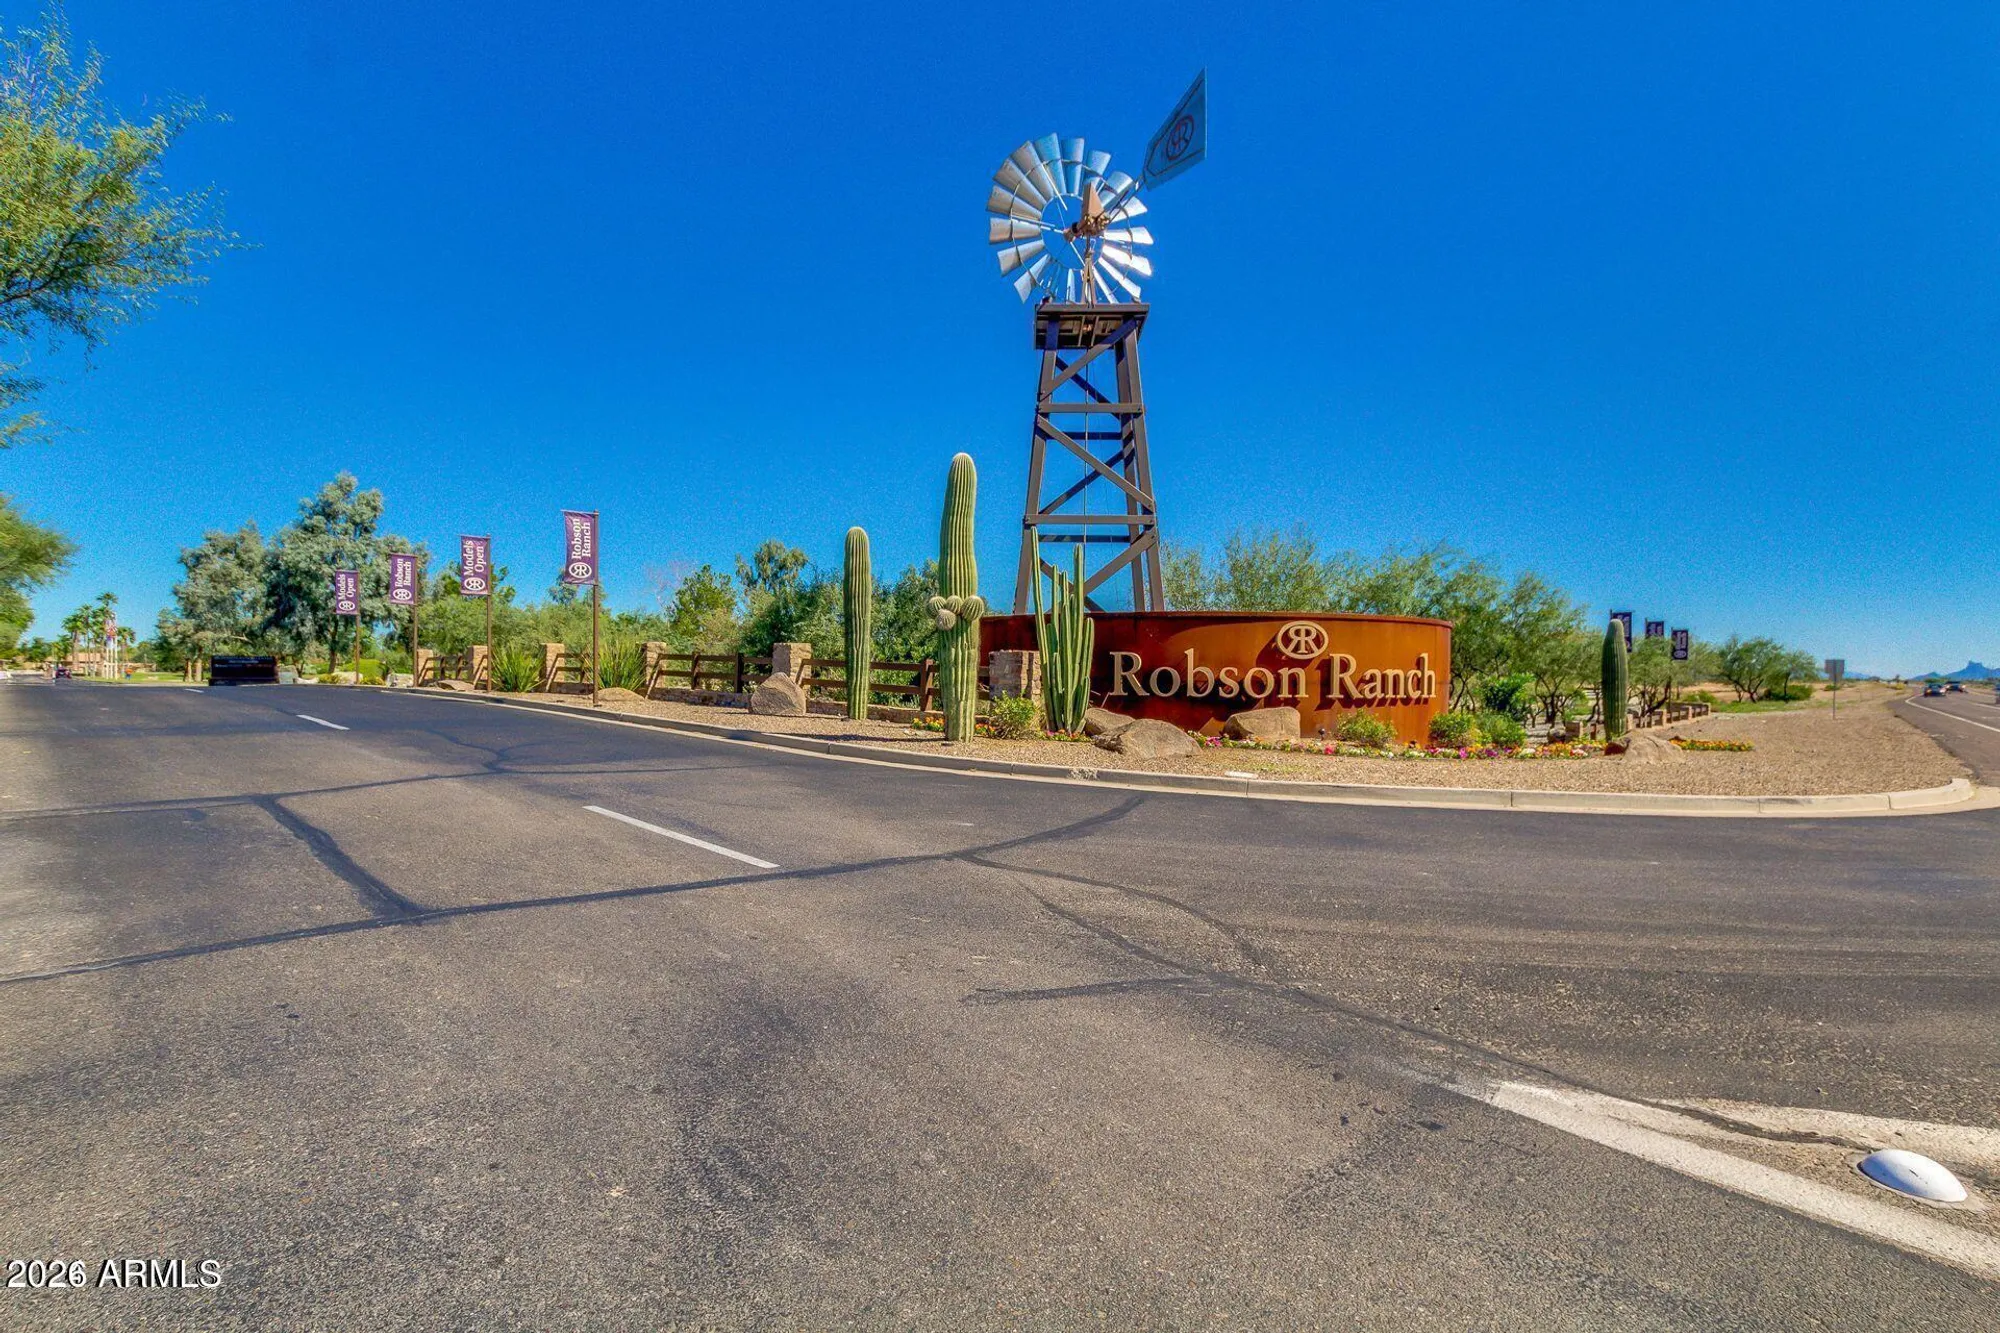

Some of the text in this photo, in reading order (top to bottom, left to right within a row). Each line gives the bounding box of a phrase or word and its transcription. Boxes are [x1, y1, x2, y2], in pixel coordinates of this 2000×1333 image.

[571, 518, 582, 560] Robson
[582, 522, 591, 557] Ranch
[463, 540, 474, 576] Models
[474, 546, 486, 572] Open
[1109, 648, 1436, 699] Robson Ranch
